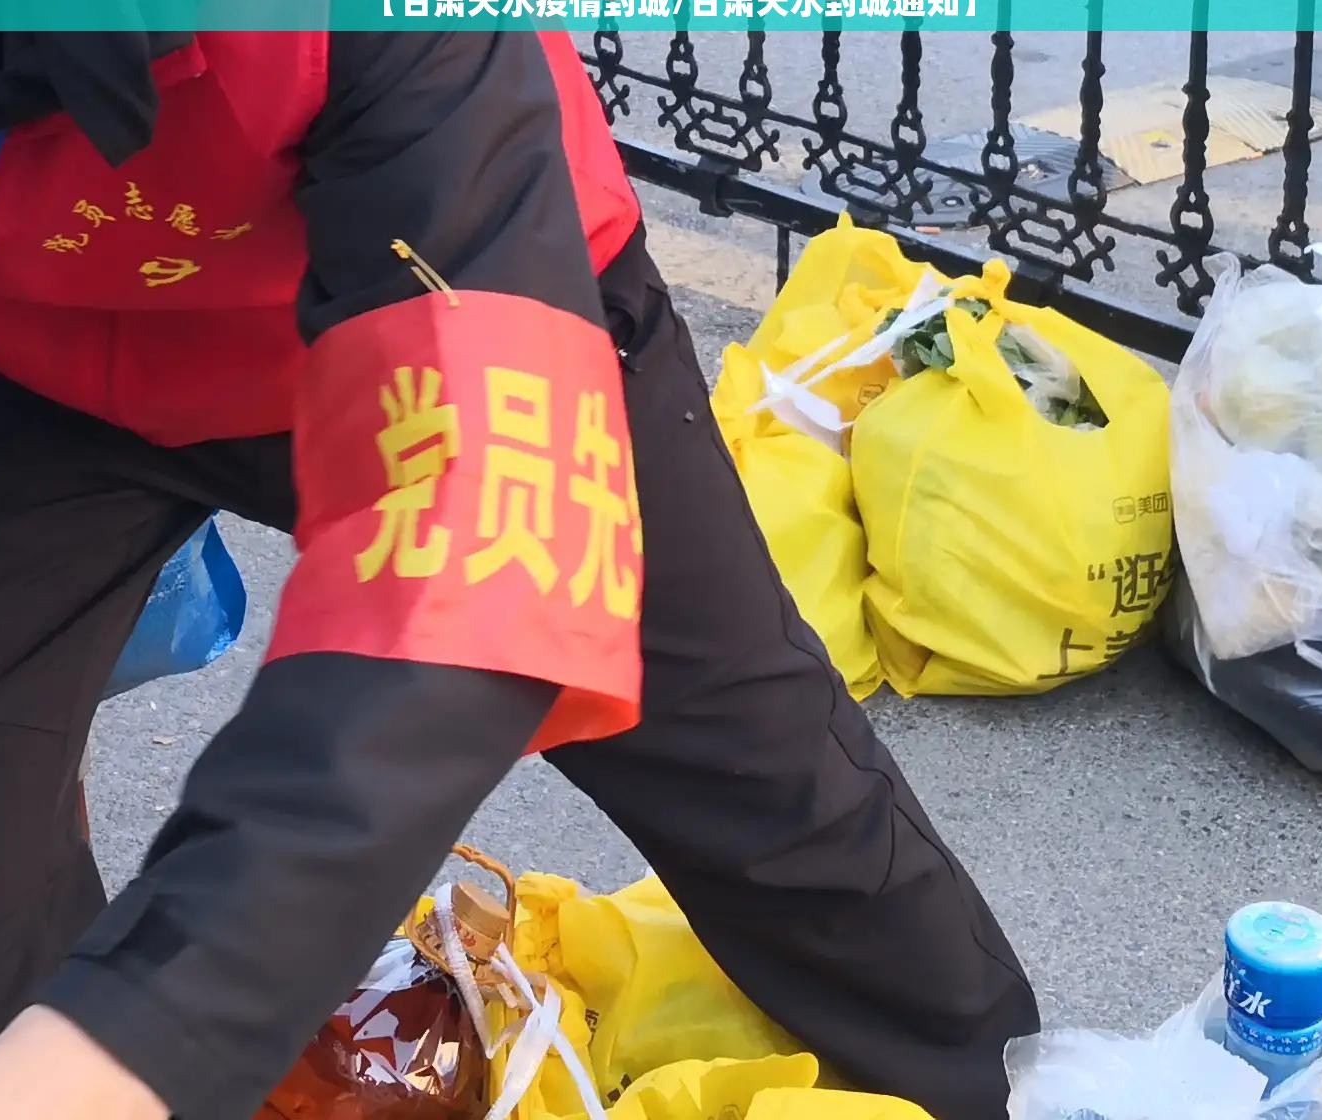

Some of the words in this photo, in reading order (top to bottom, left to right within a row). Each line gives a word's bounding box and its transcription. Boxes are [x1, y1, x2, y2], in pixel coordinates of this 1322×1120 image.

[353, 366, 643, 620] 党员先
[1137, 492, 1168, 517] 美团
